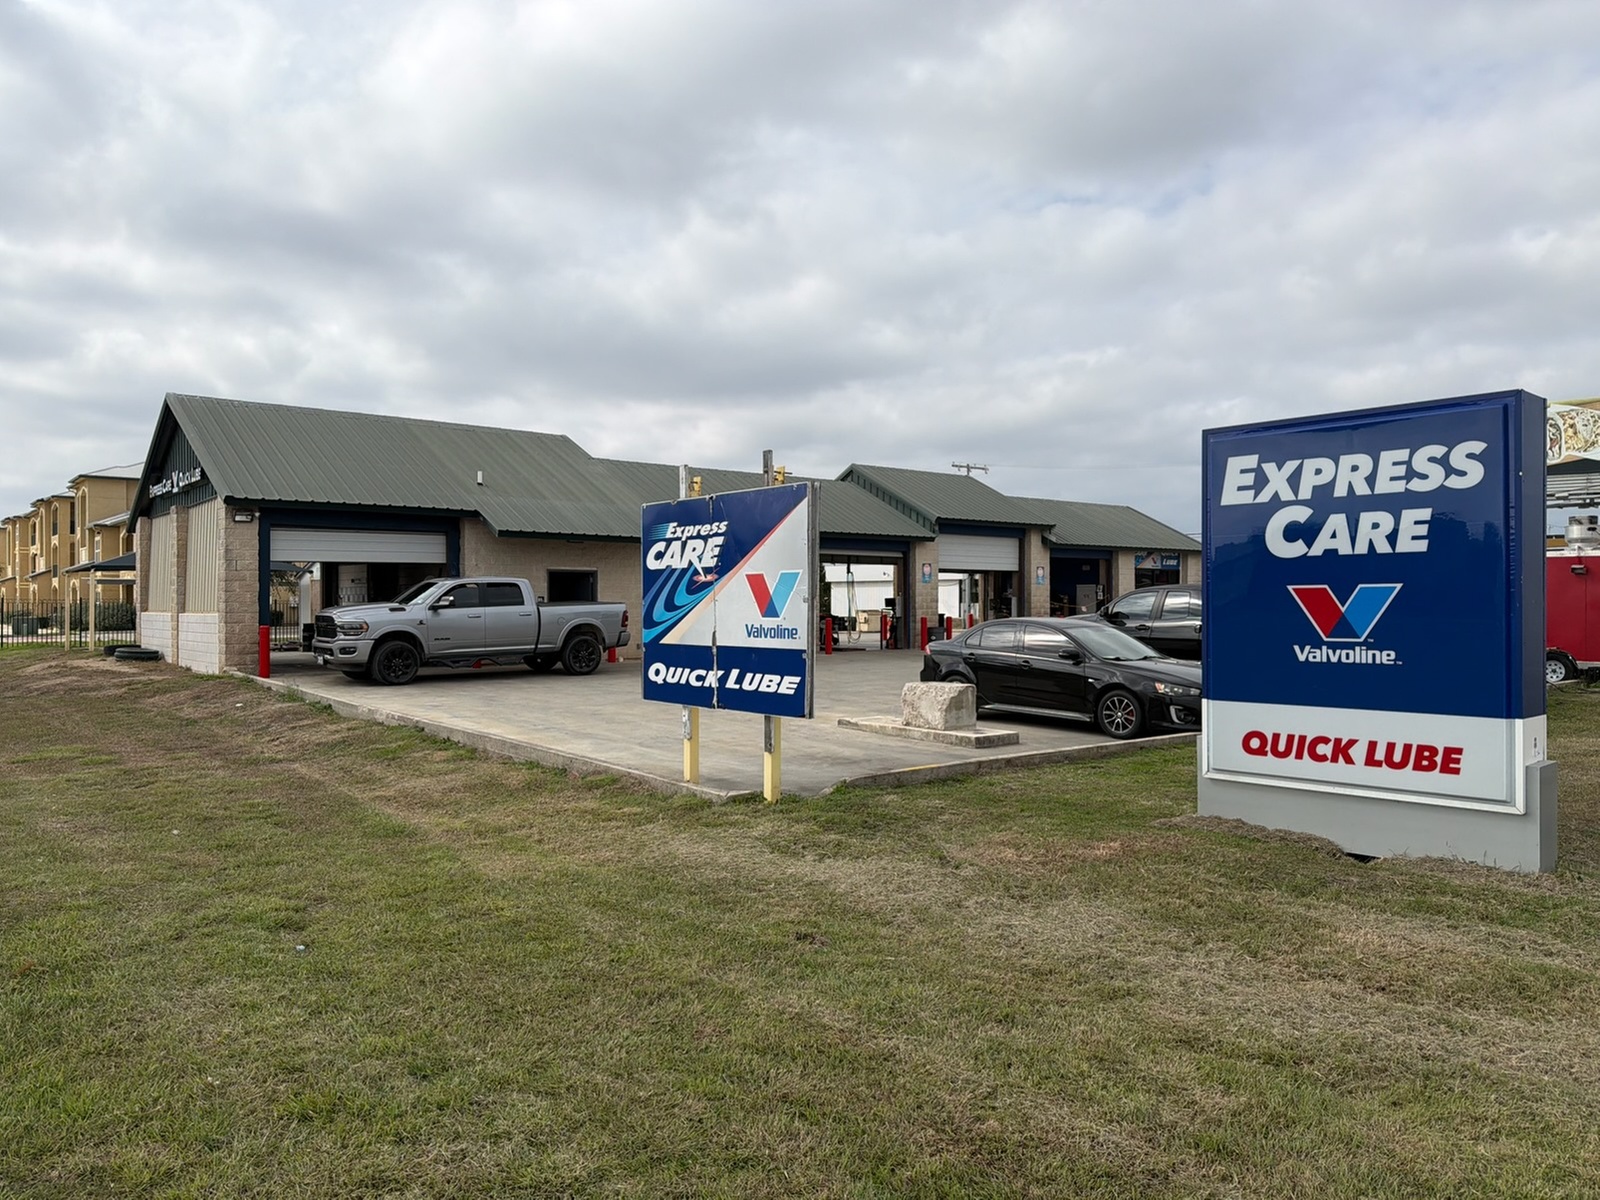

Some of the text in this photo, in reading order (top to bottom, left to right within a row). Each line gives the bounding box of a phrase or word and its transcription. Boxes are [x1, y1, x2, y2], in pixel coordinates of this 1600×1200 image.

[1220, 440, 1488, 506] EXPRESS
[665, 521, 728, 543] Express
[1265, 505, 1433, 559] CARE
[646, 536, 726, 576] CARE
[745, 623, 799, 640] Valvoline
[1293, 645, 1396, 665] Valvoline
[647, 662, 801, 695] QUICK LUBE
[1241, 730, 1464, 776] QUICK LUBE
